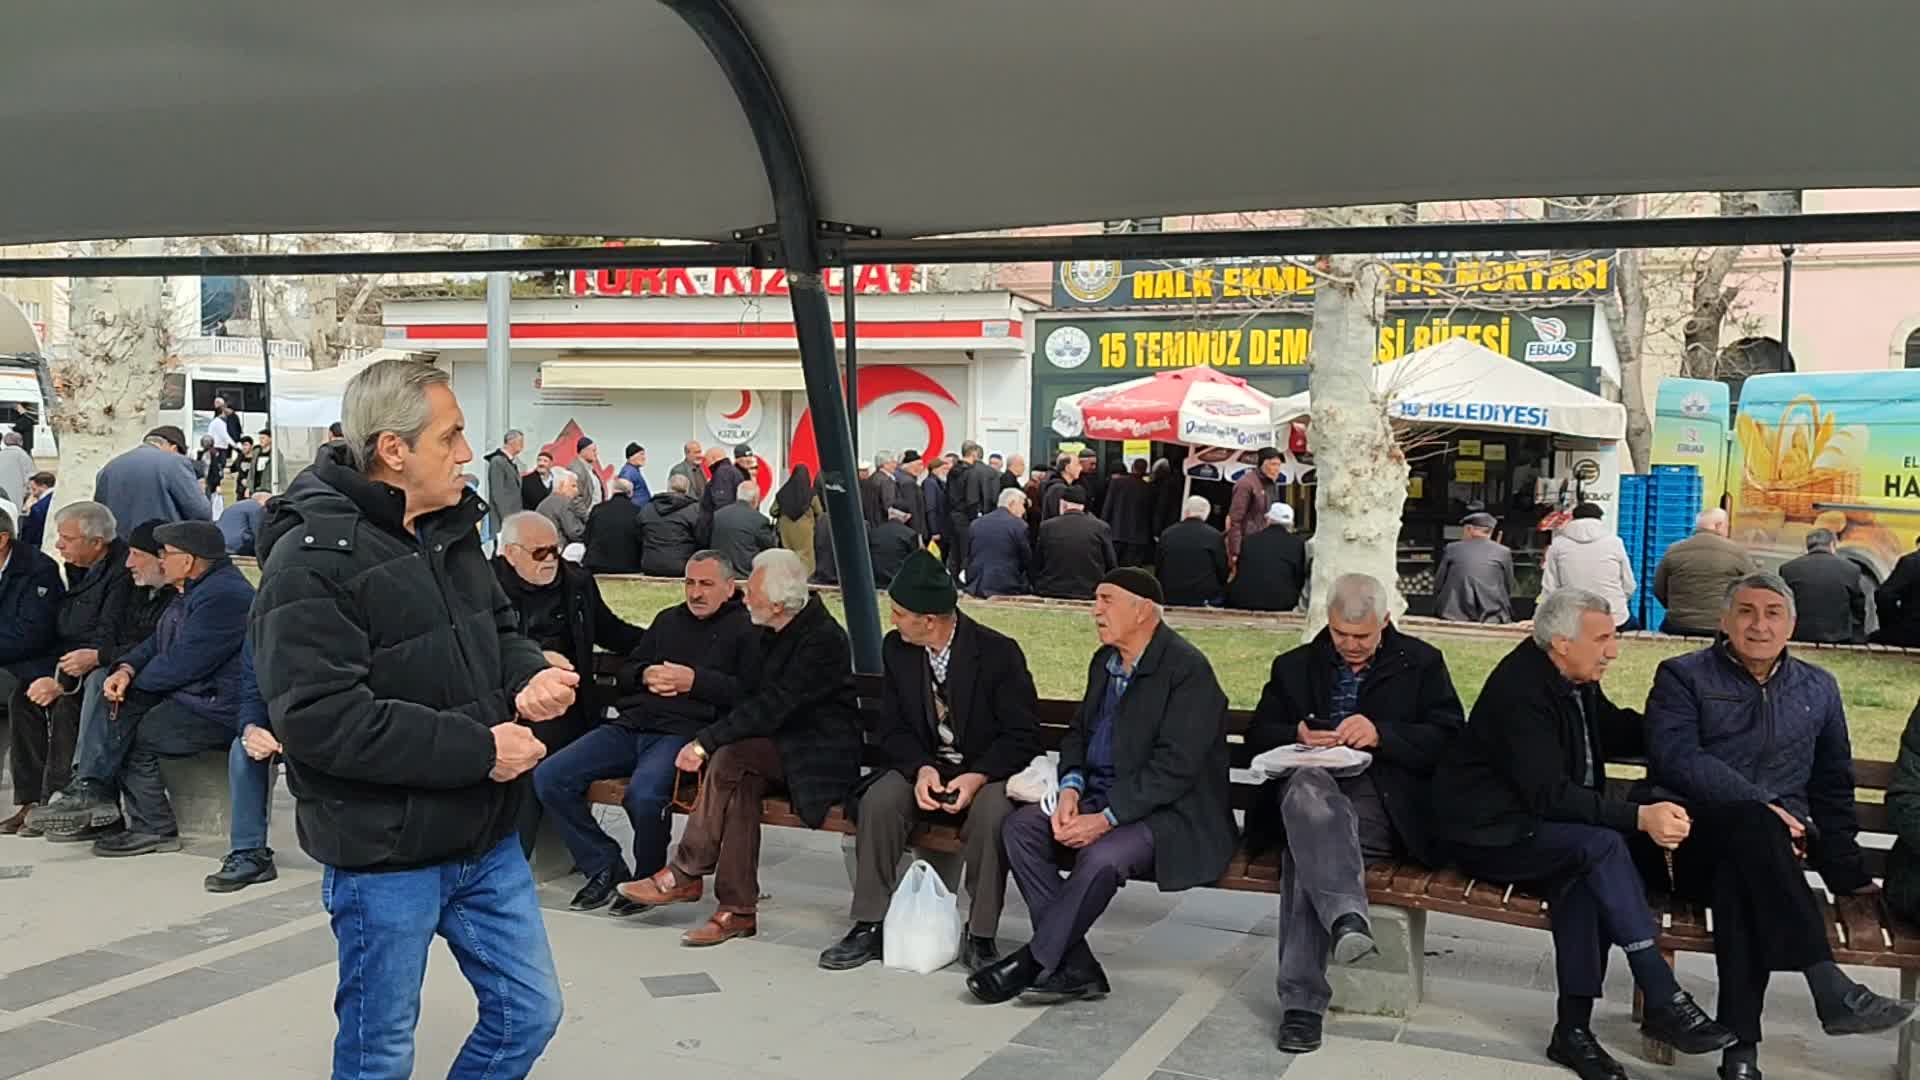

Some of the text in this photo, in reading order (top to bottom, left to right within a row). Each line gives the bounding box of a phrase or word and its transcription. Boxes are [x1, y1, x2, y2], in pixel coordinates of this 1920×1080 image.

[1134, 268, 1215, 299] HALK
[1223, 265, 1316, 297] EKME
[1099, 332, 1127, 368] 15
[1134, 330, 1243, 368] TEMMUZ
[1885, 475, 1920, 497] HA
